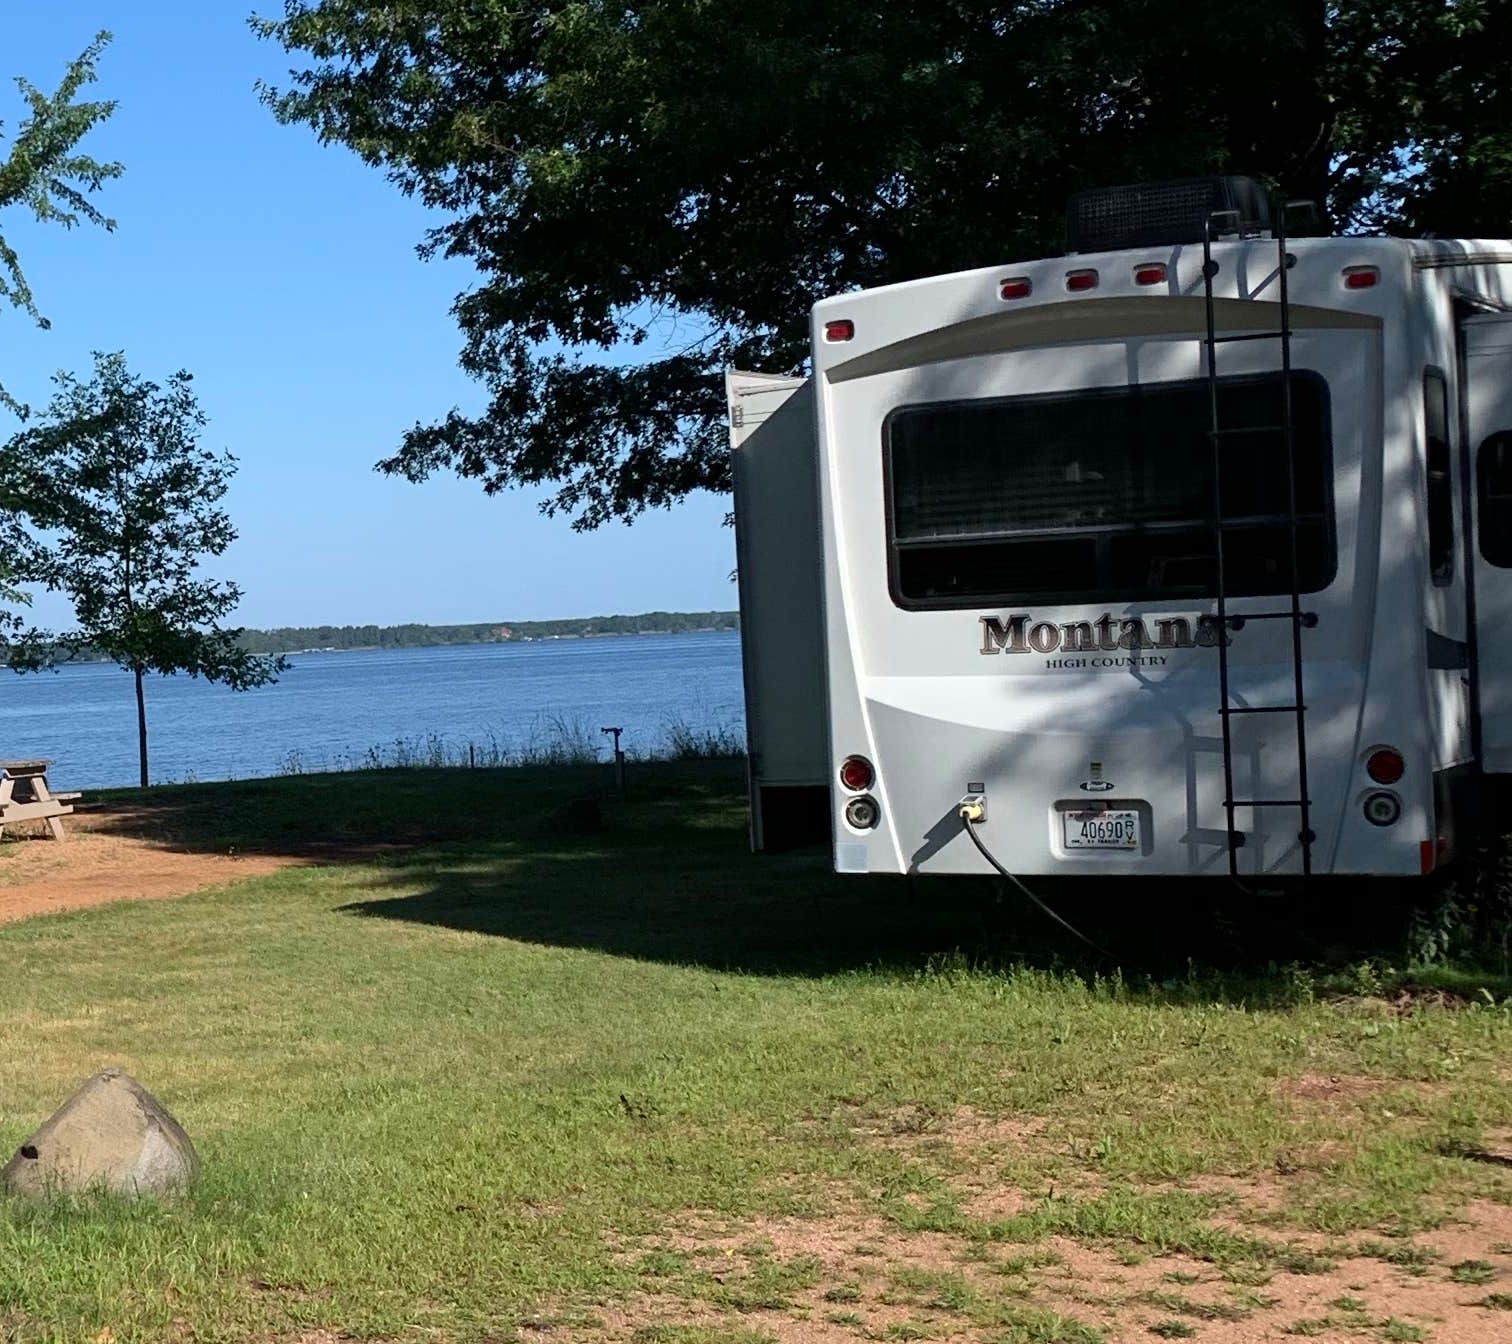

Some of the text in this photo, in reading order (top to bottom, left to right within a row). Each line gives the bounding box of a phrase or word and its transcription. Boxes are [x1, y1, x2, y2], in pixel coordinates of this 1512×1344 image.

[978, 612, 1232, 655] Montana
[1046, 655, 1169, 670] HIGH COUNTRY
[1080, 821, 1123, 839] 40690
